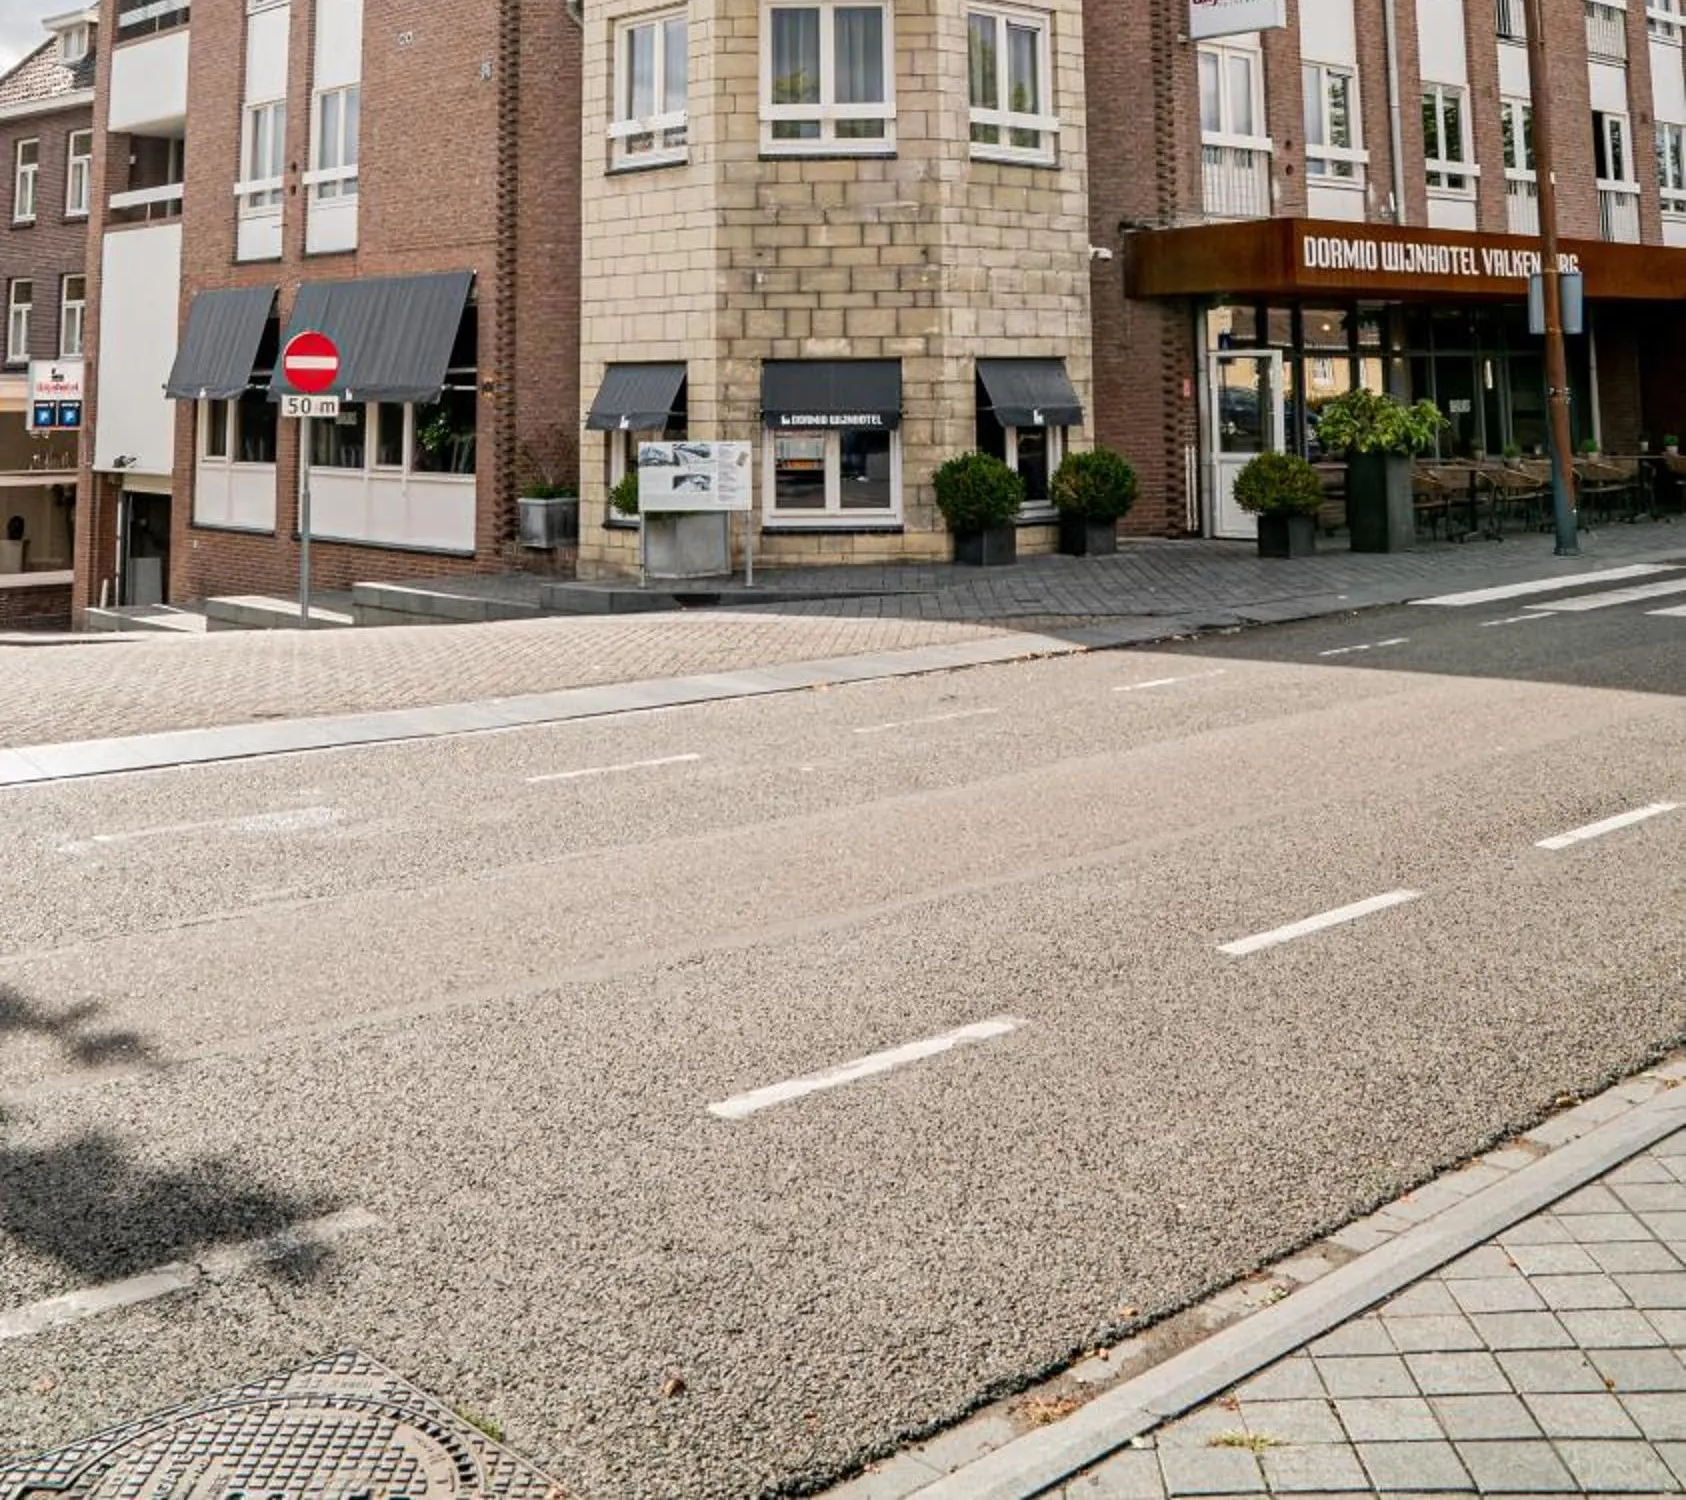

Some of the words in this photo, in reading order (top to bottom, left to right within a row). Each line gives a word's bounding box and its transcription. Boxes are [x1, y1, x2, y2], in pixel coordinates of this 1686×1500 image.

[1303, 236, 1378, 271] DORMIO
[1381, 241, 1480, 276] WIJNHOTEL
[1482, 248, 1580, 278] VALKENRG
[288, 397, 311, 414] 50
[320, 402, 335, 413] m
